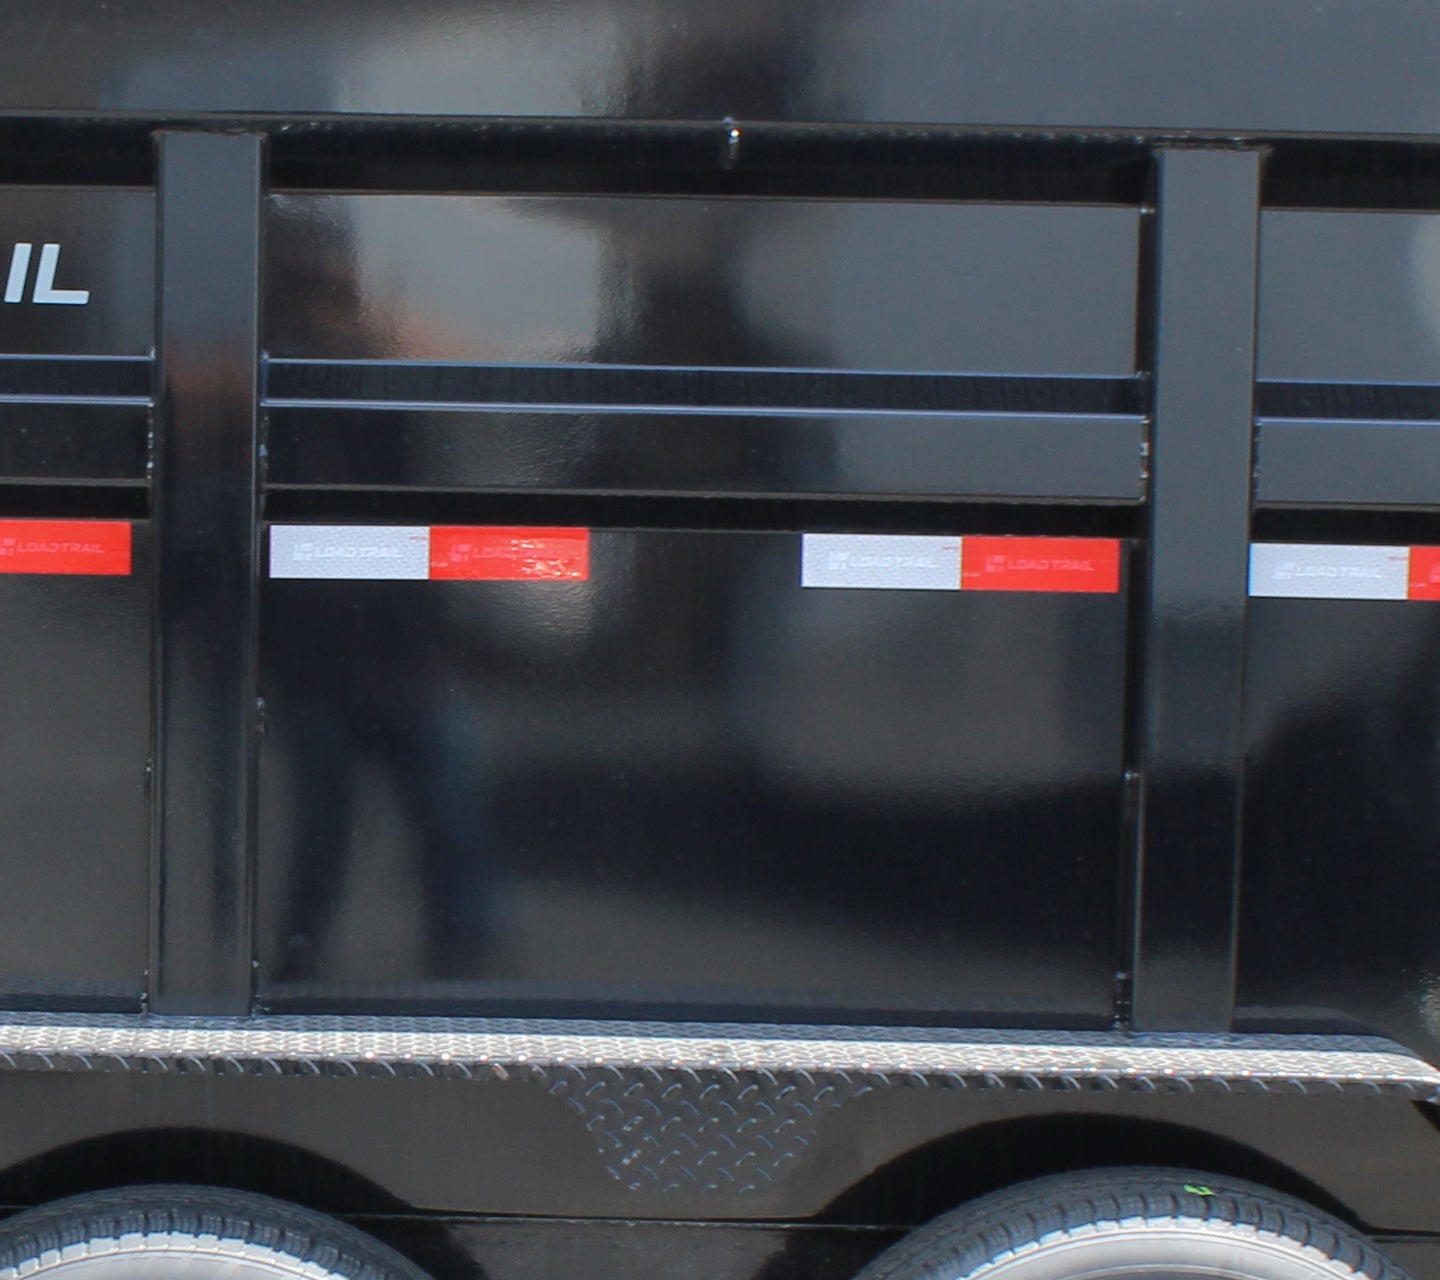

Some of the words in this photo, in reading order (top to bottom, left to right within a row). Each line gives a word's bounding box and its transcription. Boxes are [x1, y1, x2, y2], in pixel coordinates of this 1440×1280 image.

[17, 541, 59, 553] LOAD
[472, 547, 512, 559] LOAD
[1007, 559, 1049, 570] LOAD
